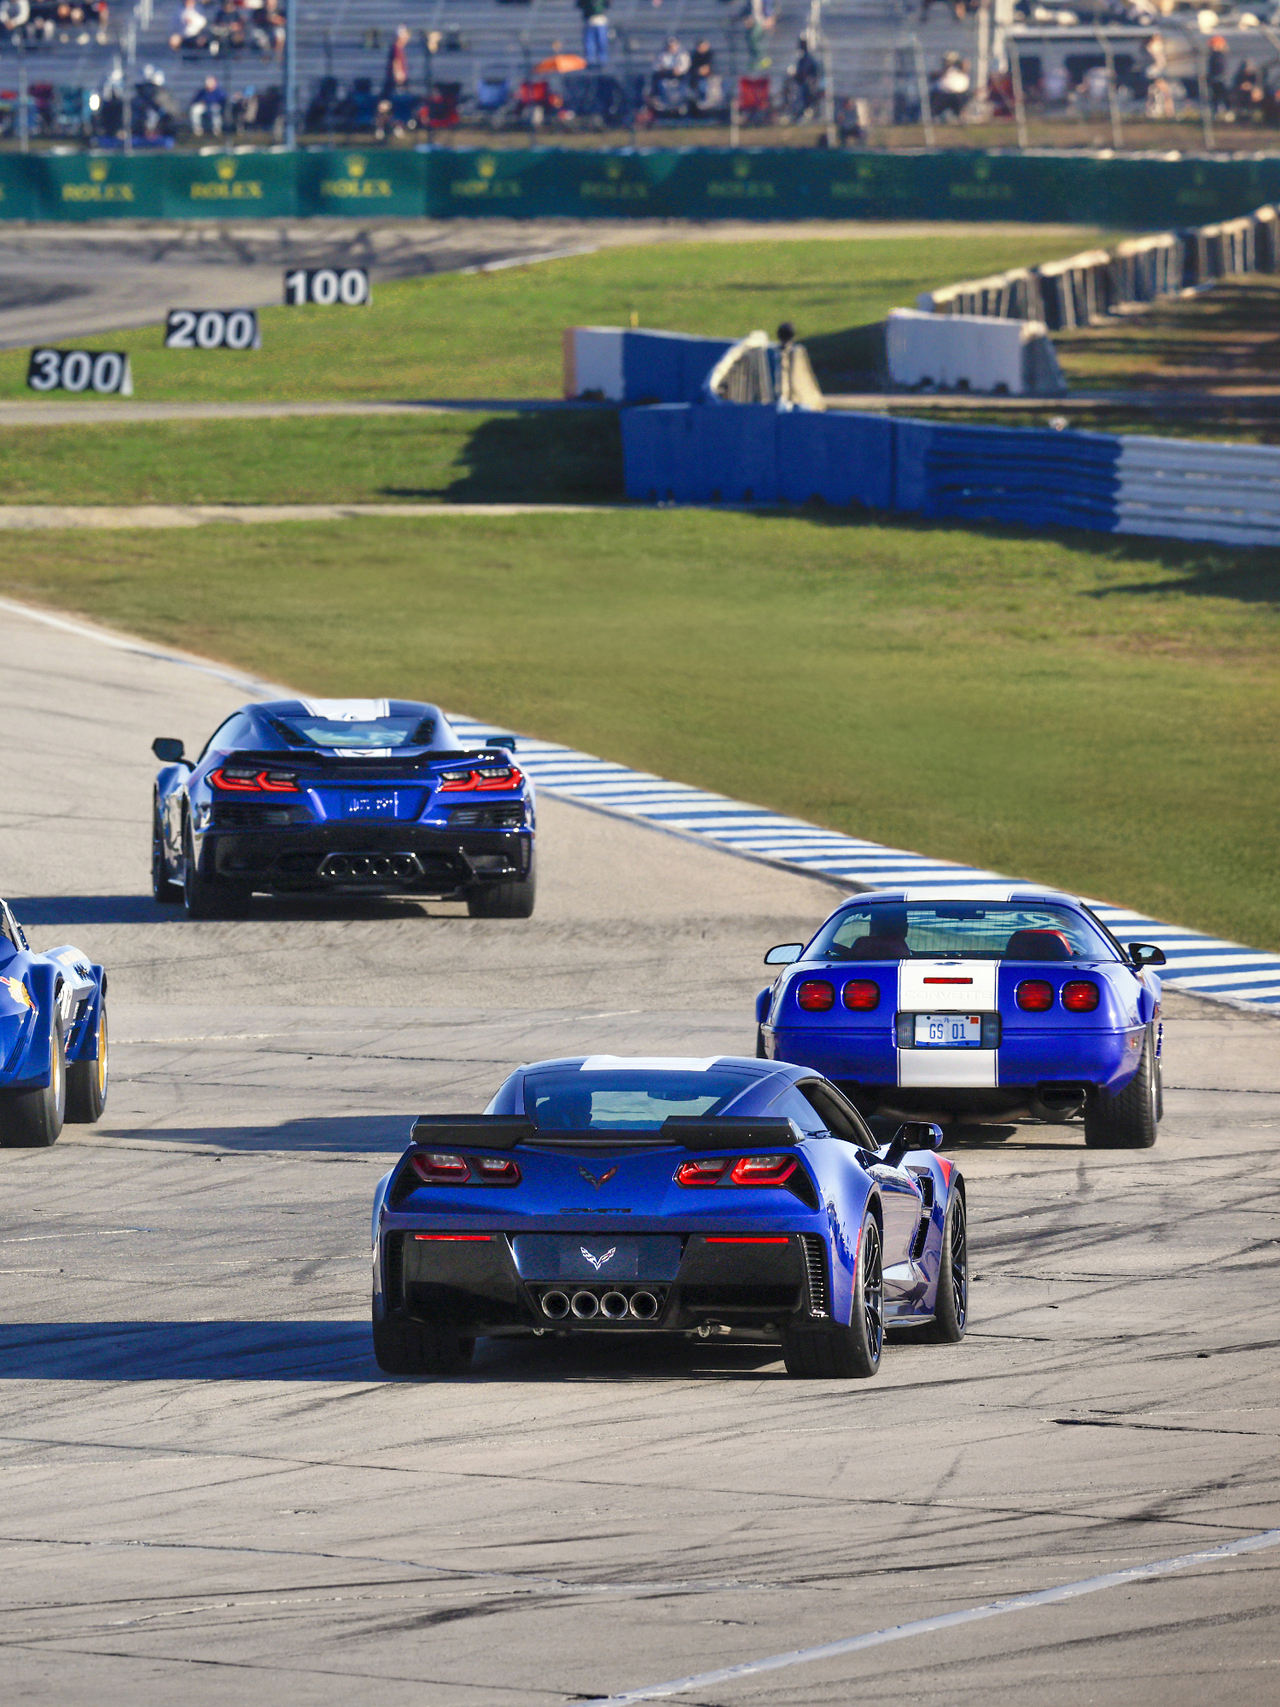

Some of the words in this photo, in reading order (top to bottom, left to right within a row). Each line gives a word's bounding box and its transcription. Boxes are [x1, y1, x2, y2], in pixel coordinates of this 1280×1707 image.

[61, 182, 134, 200] ROLEX
[190, 180, 262, 199] ROLEX
[320, 178, 391, 197] ROLEX
[286, 268, 368, 306] 100
[166, 310, 254, 349] 200
[30, 348, 122, 392] 300
[904, 990, 993, 999] CORVETTE
[929, 1023, 944, 1039] GS
[952, 1023, 966, 1039] 01
